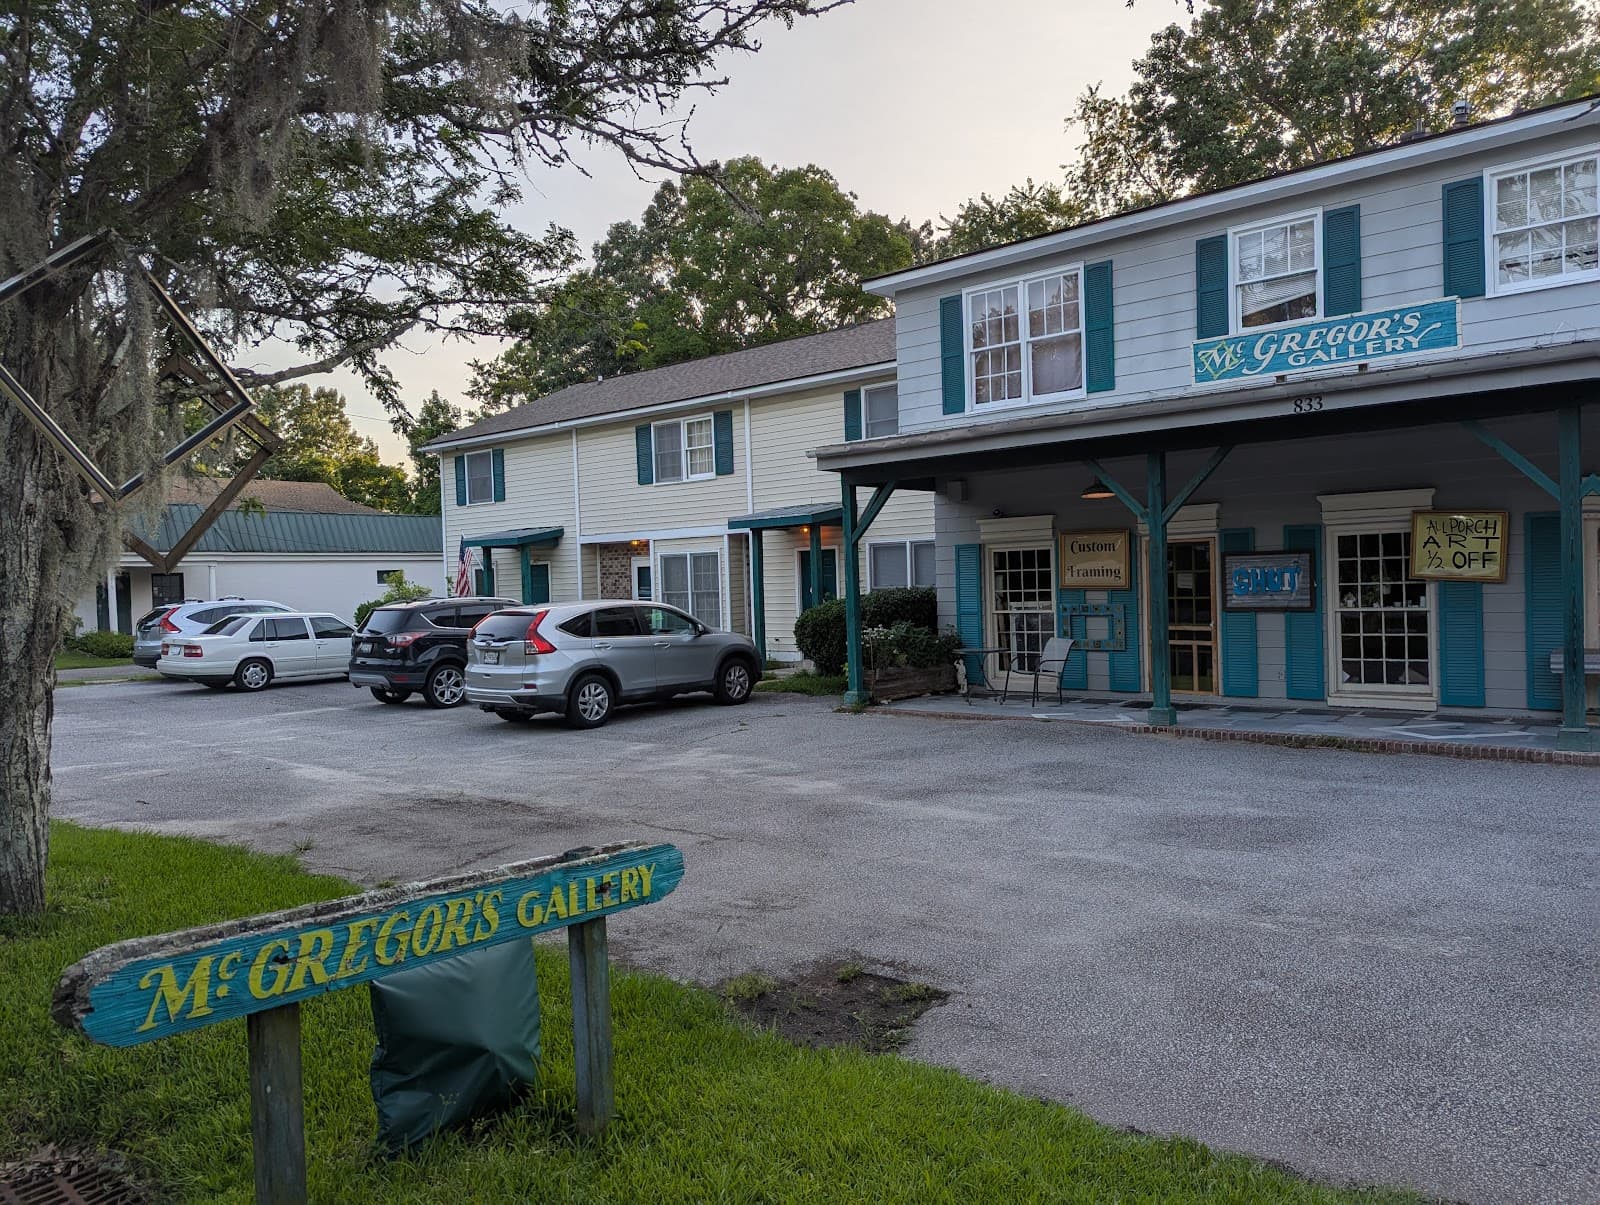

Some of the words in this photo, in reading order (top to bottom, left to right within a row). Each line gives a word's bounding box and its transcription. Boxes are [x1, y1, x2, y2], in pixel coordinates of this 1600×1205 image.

[1288, 322, 1441, 366] GALLERY
[1293, 396, 1323, 413] 833
[1426, 519, 1447, 536] ALL
[1449, 518, 1497, 537] PORCH
[1070, 540, 1116, 555] Custom
[1422, 534, 1500, 550] ART
[1452, 551, 1498, 569] OFF
[1067, 565, 1122, 581] Framing
[1232, 563, 1302, 597] SHUT
[517, 863, 656, 928] GALLERY
